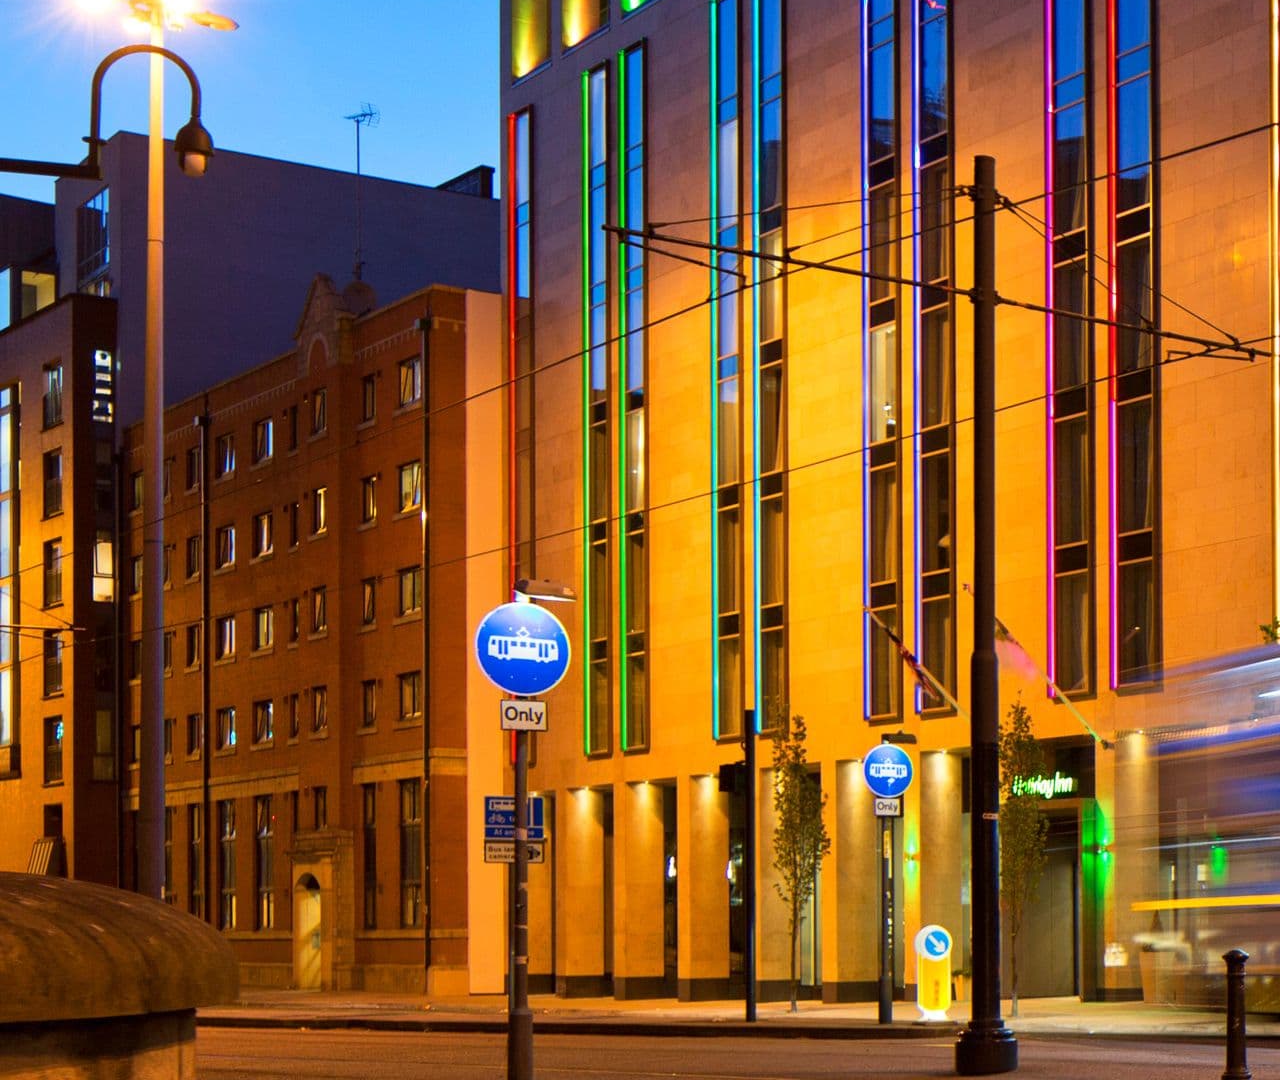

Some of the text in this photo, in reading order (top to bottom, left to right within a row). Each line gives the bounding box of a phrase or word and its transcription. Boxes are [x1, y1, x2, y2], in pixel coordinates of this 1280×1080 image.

[505, 706, 544, 725] Only
[1054, 770, 1073, 793] Inn
[877, 801, 897, 812] Only
